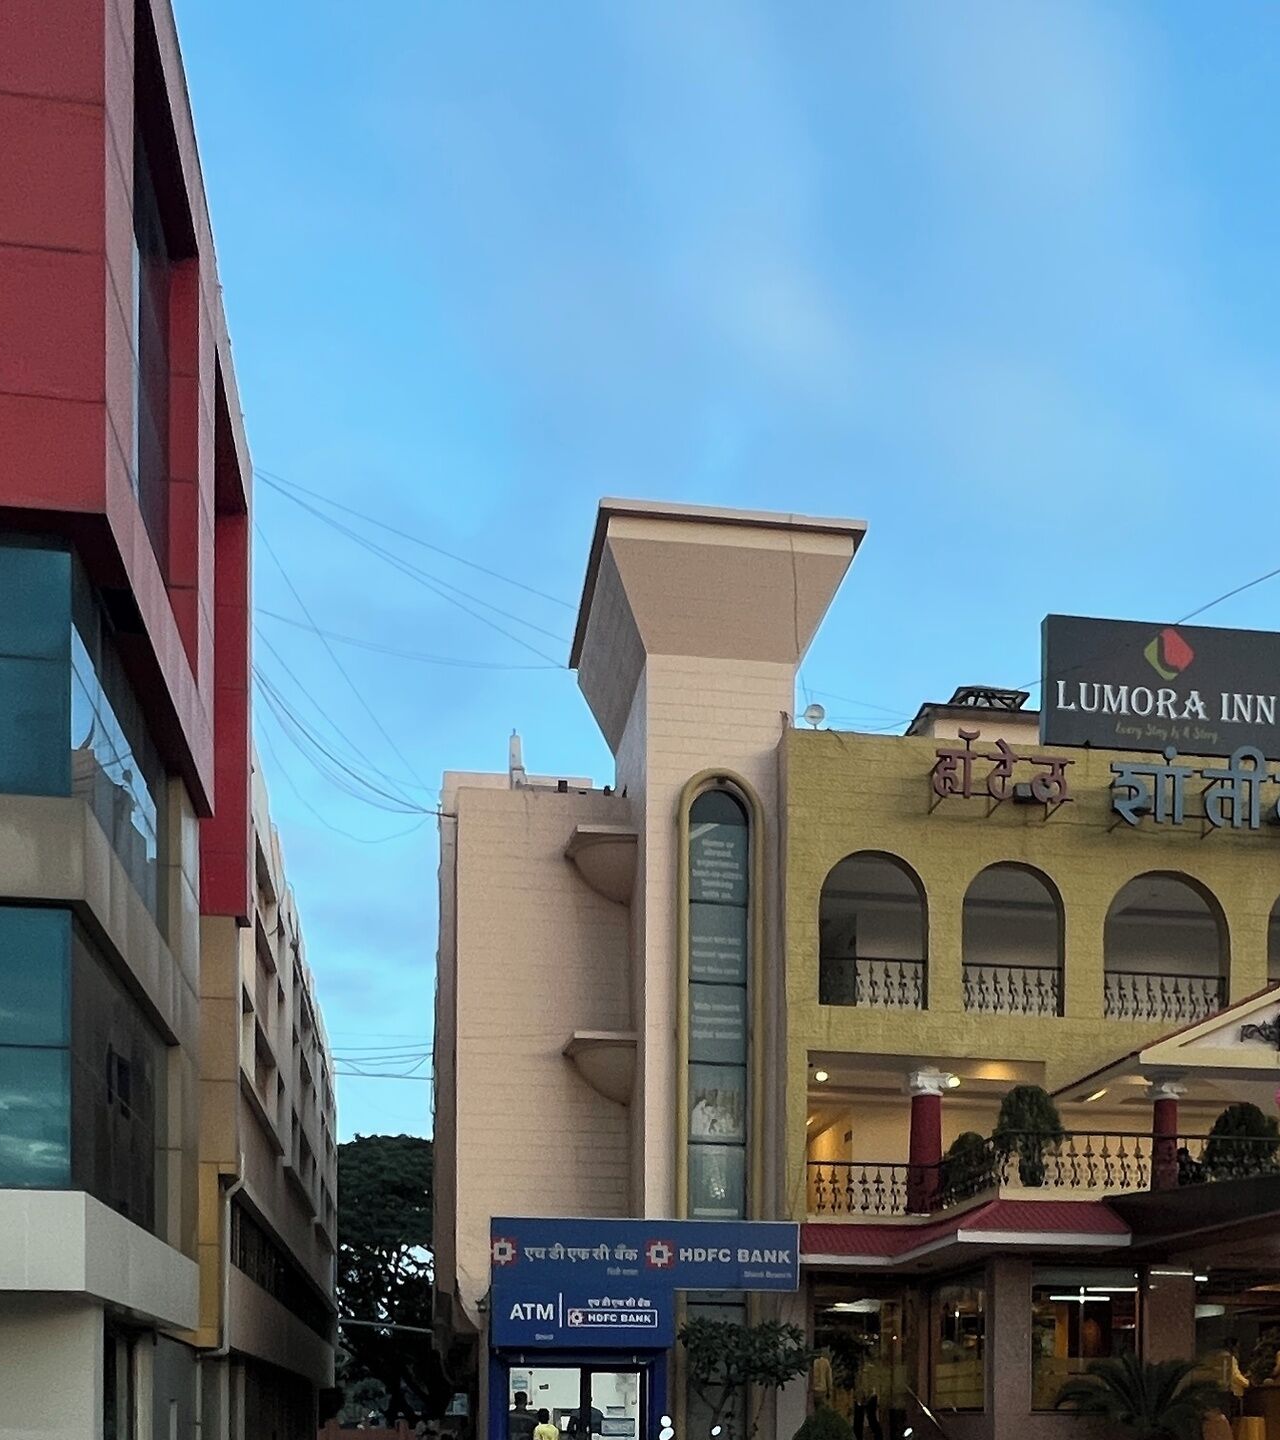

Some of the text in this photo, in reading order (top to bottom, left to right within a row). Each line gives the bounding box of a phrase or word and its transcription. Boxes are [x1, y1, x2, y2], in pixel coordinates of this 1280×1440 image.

[1056, 680, 1276, 726] LUMORA INN
[933, 727, 1072, 804] हॉटेल
[679, 1248, 791, 1265] HDFC BANK
[510, 1304, 554, 1321] ATM
[588, 1313, 652, 1324] HDFC BANK
